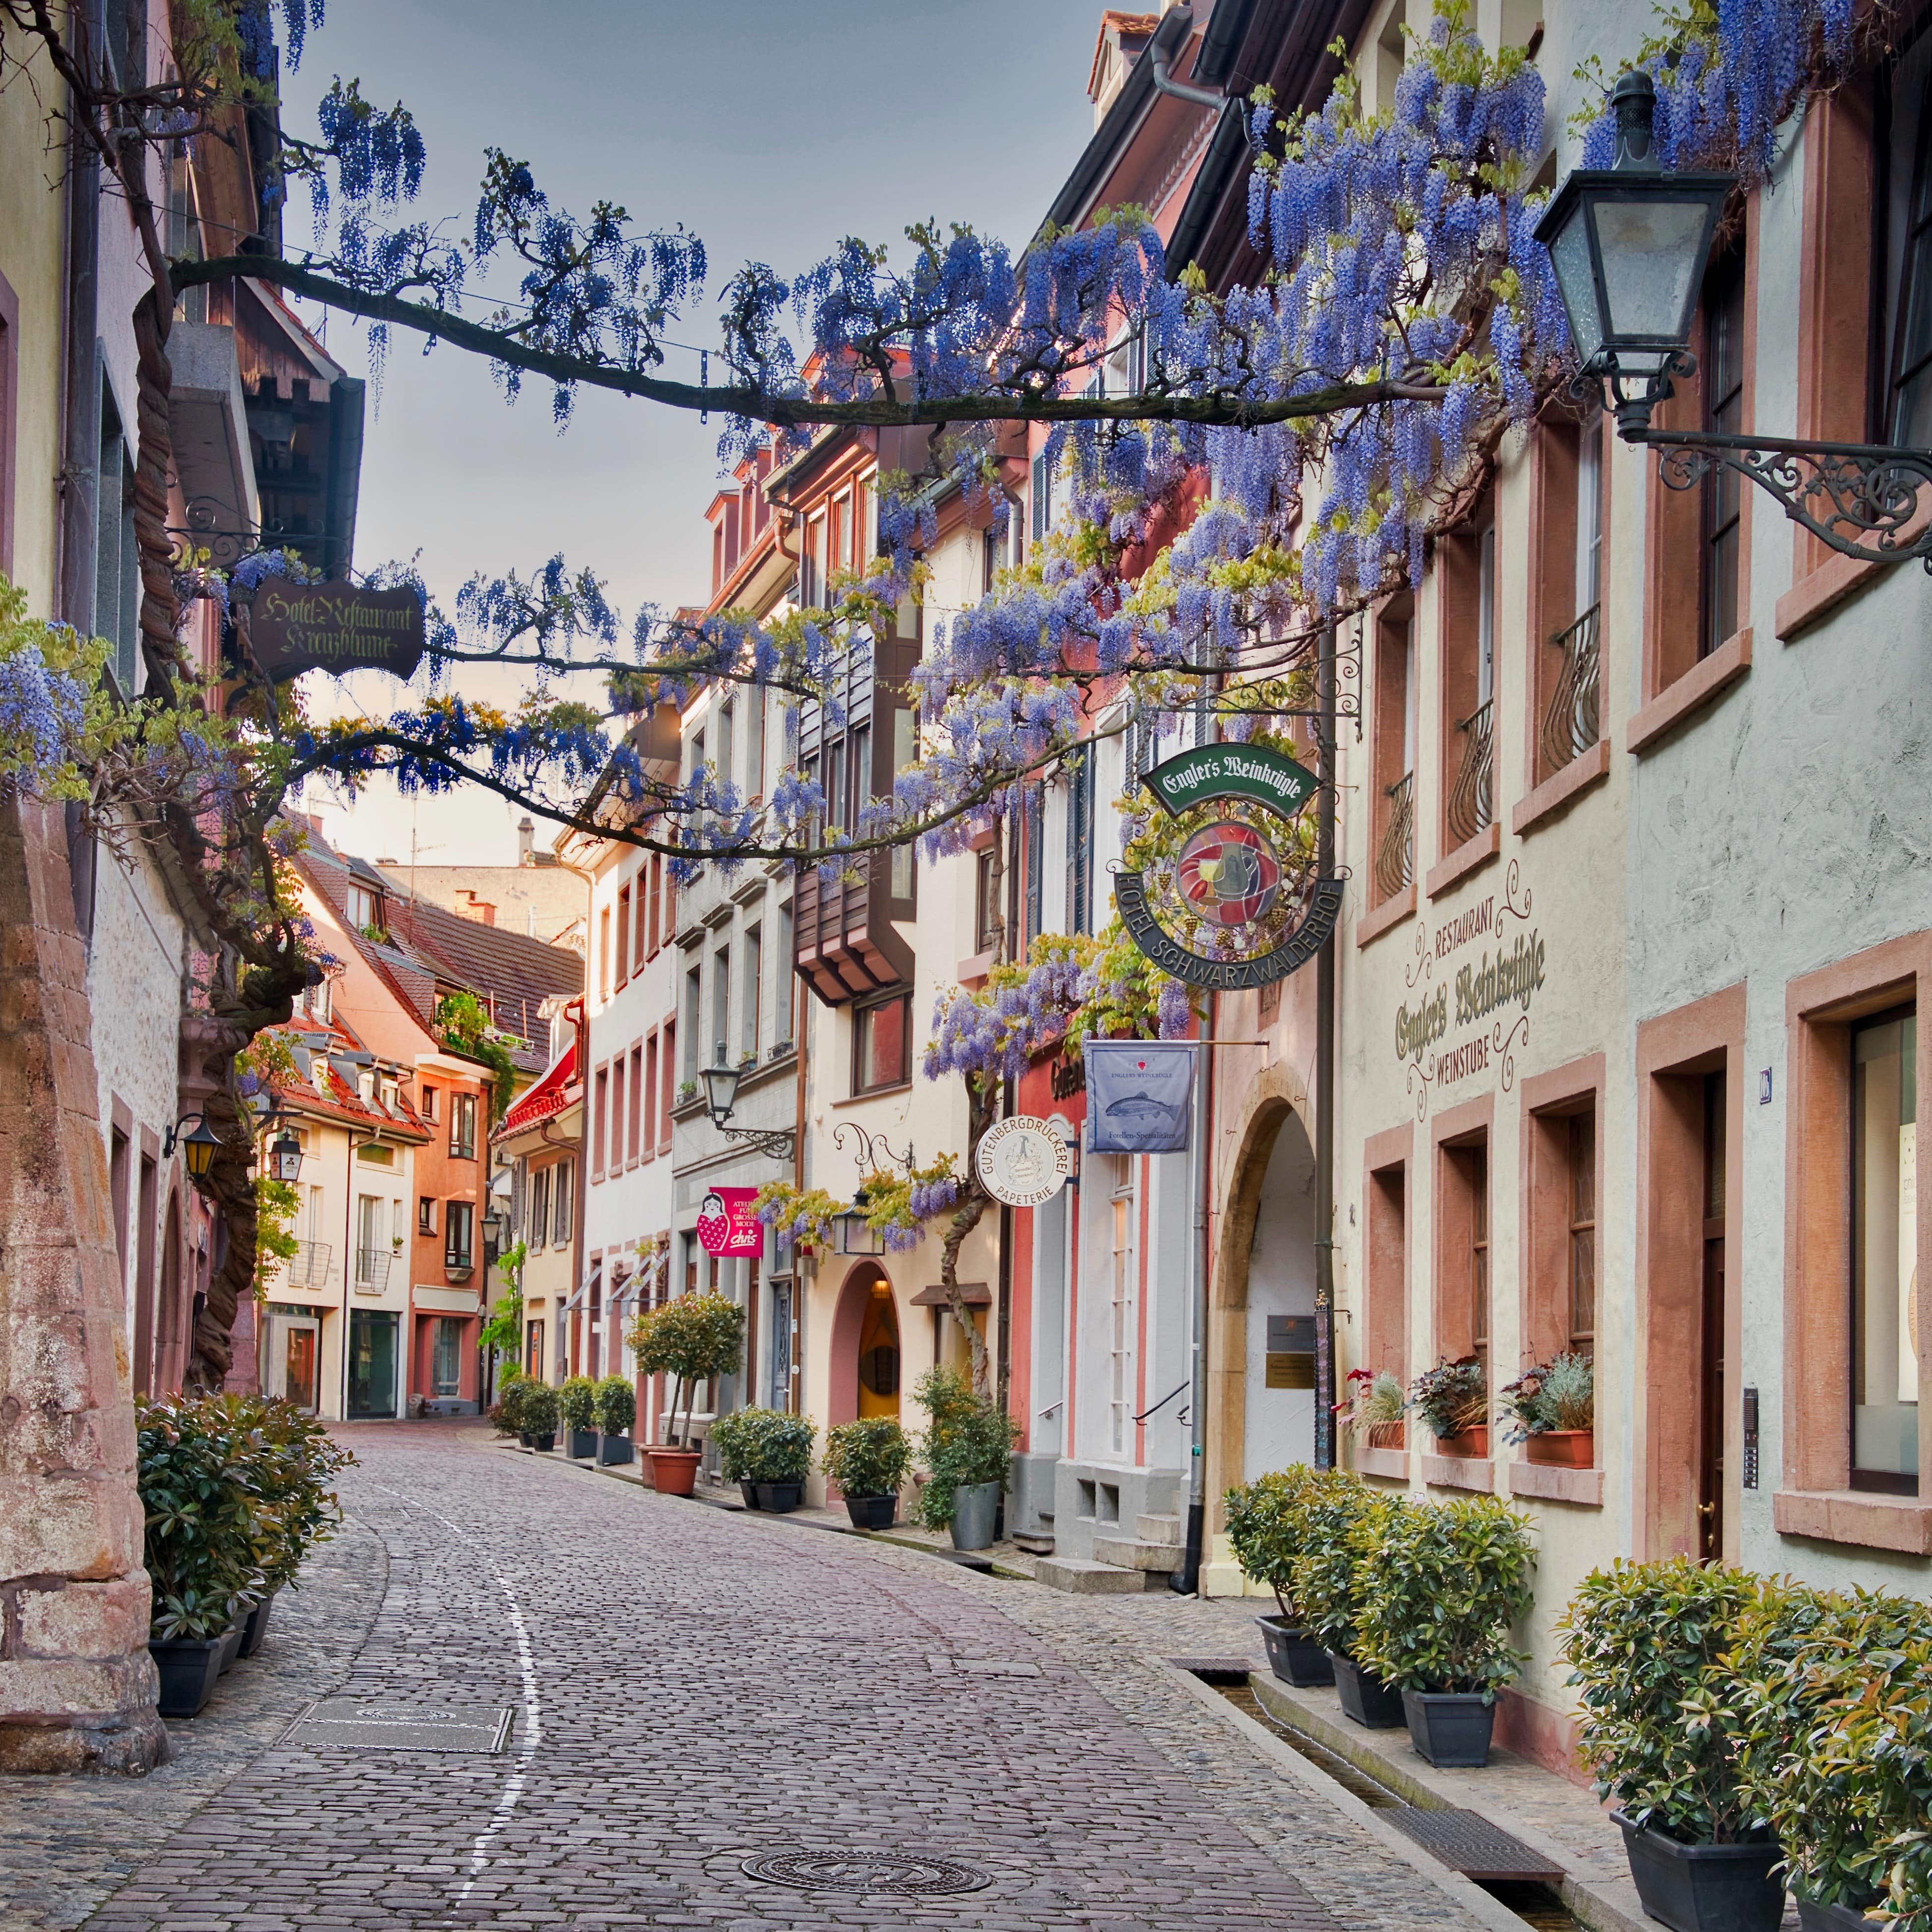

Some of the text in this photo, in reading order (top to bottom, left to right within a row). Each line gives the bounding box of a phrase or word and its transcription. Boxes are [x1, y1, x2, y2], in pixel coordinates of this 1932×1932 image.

[281, 625, 398, 663] Kreuzblume
[1162, 756, 1301, 798] Engler's Weinkrügle
[1118, 876, 1340, 987] HOTEL SCHWARZWÄLDERHOF
[1435, 896, 1494, 960] RESTAURANT
[1396, 928, 1545, 1064] Engler's Weinkrügle
[1437, 1034, 1489, 1088] WEINSTUBE
[981, 1118, 1068, 1174] GUTENBERGDRUCKEREI
[996, 1186, 1053, 1204] PAPETERIE
[730, 1229, 757, 1245] chris
